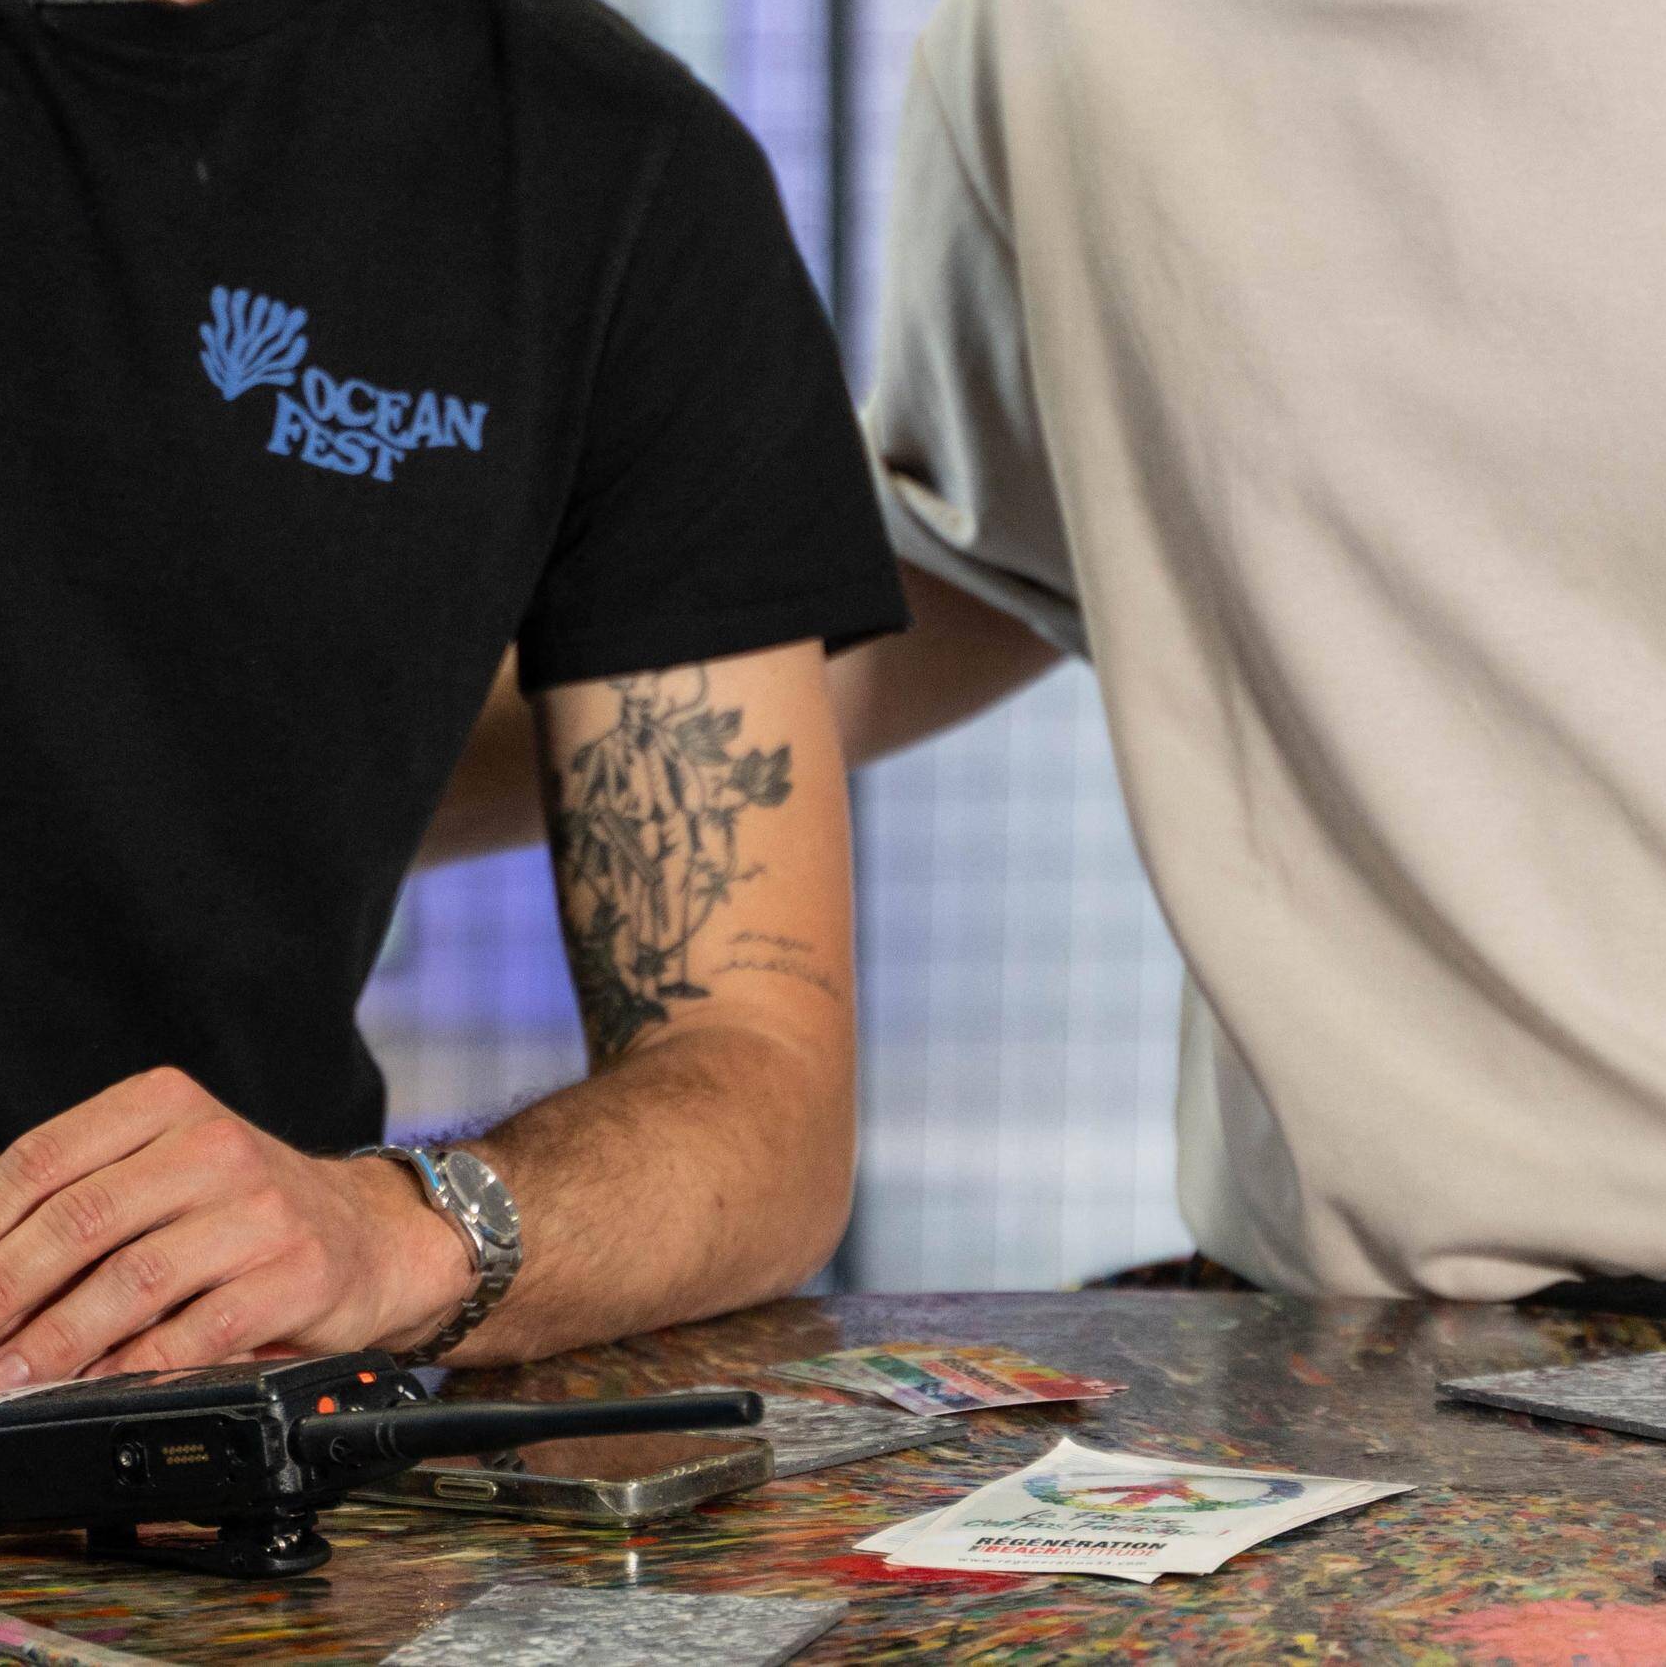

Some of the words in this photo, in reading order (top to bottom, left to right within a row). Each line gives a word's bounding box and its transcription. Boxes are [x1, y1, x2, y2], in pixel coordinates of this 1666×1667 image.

[266, 392, 406, 483] FEST
[301, 365, 489, 452] OCEAN
[976, 1536, 1168, 1550] RÉGÉNÉRATION
